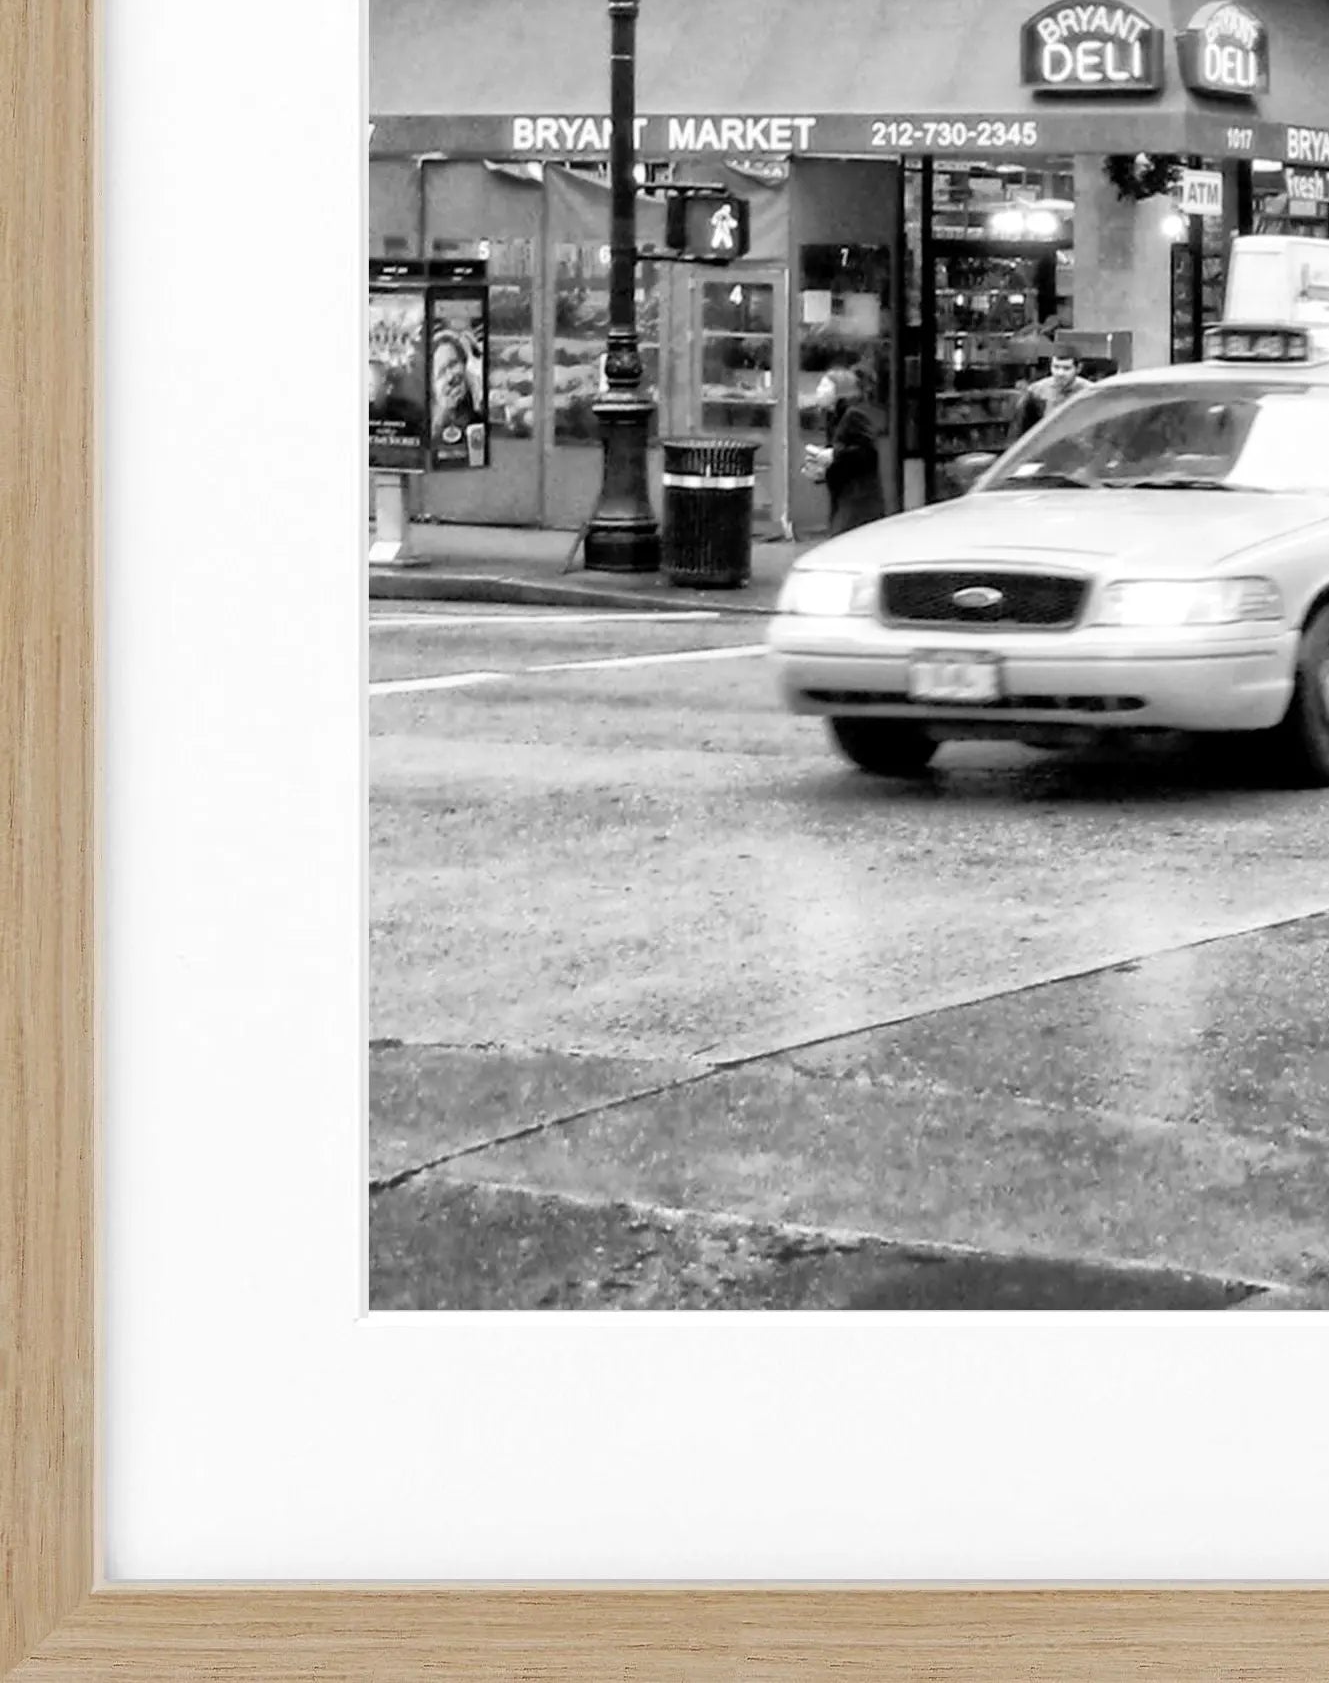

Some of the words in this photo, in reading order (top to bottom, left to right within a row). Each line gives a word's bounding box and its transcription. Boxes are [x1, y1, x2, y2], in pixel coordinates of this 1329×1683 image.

[1037, 5, 1151, 44] BRYANT
[1042, 40, 1142, 83] DELI
[1204, 42, 1256, 87] DELI
[668, 117, 816, 151] MARKET
[871, 121, 1038, 146] 212-730-2345
[1227, 128, 1253, 150] 1017
[1187, 179, 1219, 206] ATM
[478, 240, 490, 260] 5
[840, 247, 850, 267] 7
